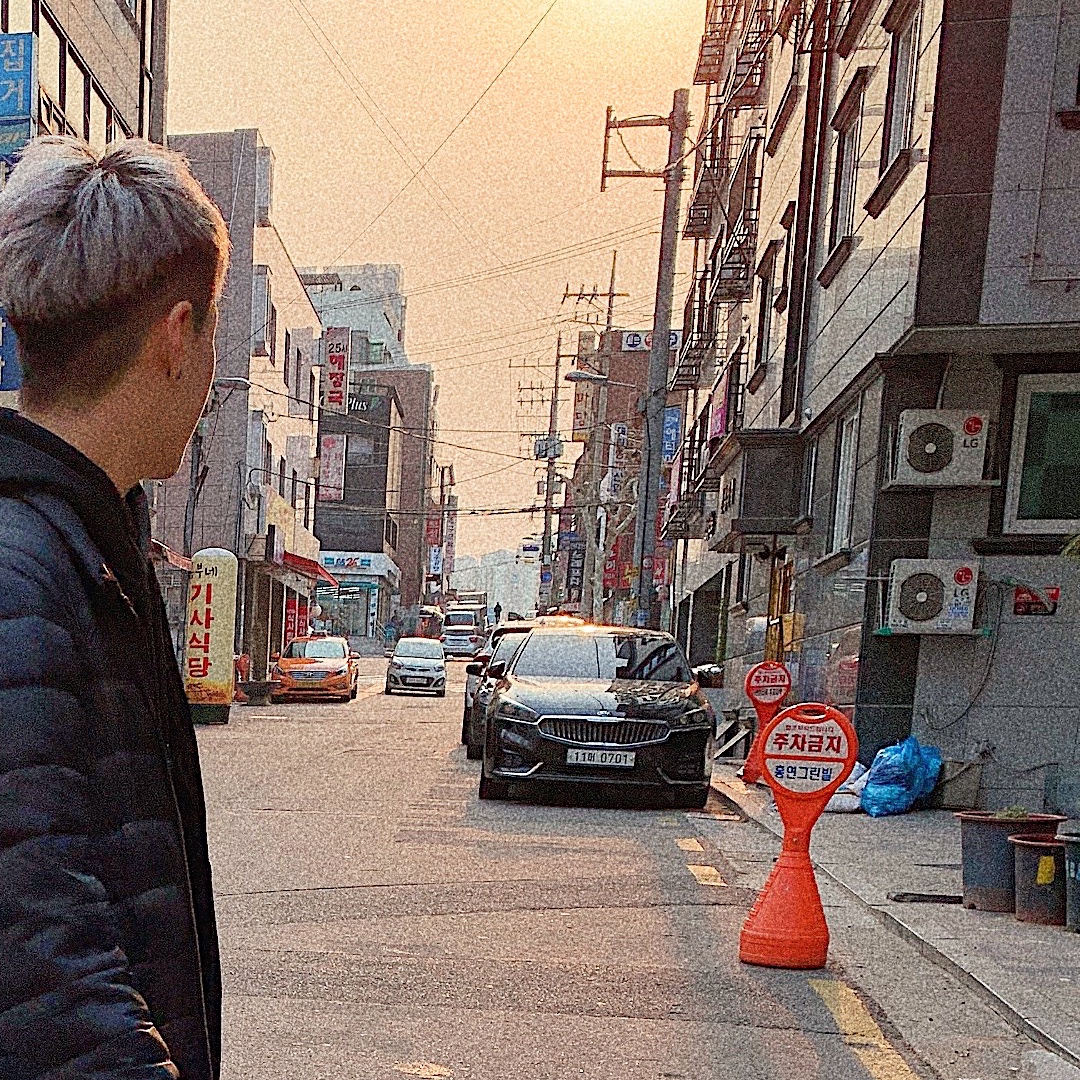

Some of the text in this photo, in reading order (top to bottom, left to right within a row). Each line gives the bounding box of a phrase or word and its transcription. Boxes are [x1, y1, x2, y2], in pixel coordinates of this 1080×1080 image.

[962, 438, 979, 449] LG
[953, 588, 969, 599] LG
[188, 583, 215, 678] 기사식당
[772, 732, 843, 754] 주차금지
[600, 752, 629, 765] 0701
